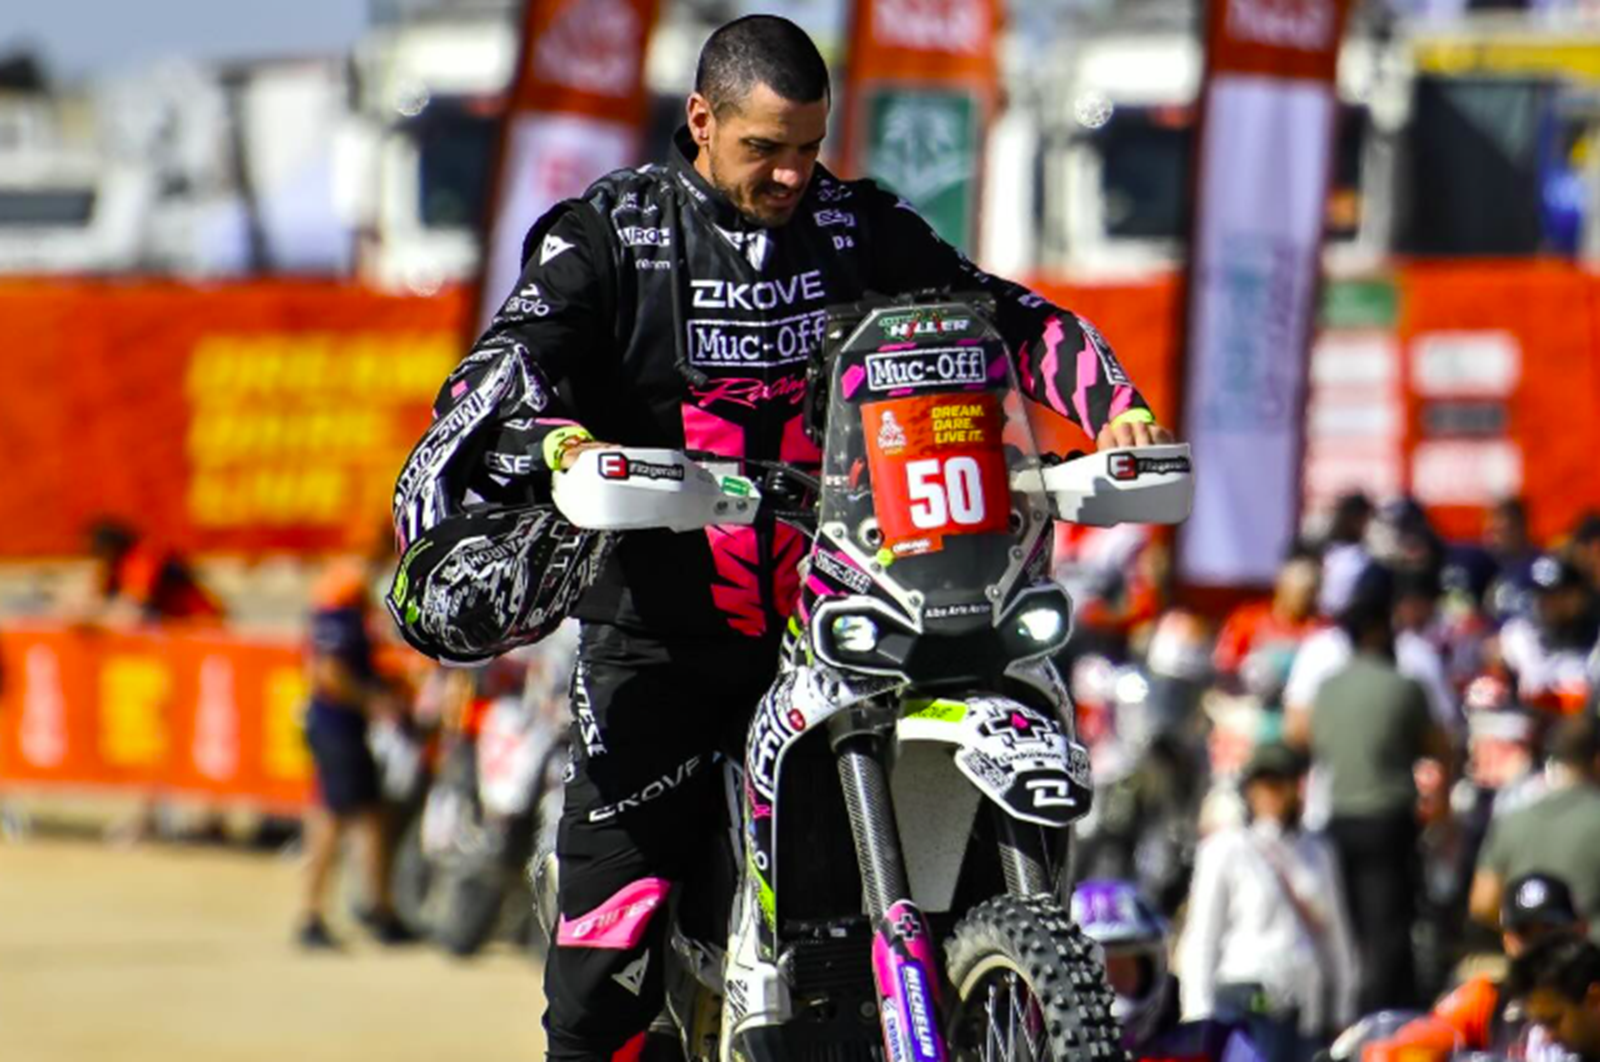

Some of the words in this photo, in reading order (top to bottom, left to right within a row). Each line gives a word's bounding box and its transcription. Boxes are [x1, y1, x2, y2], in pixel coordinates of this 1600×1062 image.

[872, 351, 981, 386] Muc-Off
[931, 404, 984, 419] DREAM.
[935, 430, 966, 444] LIVE
[906, 456, 986, 529] 50
[904, 965, 936, 1058] MICHELIN
